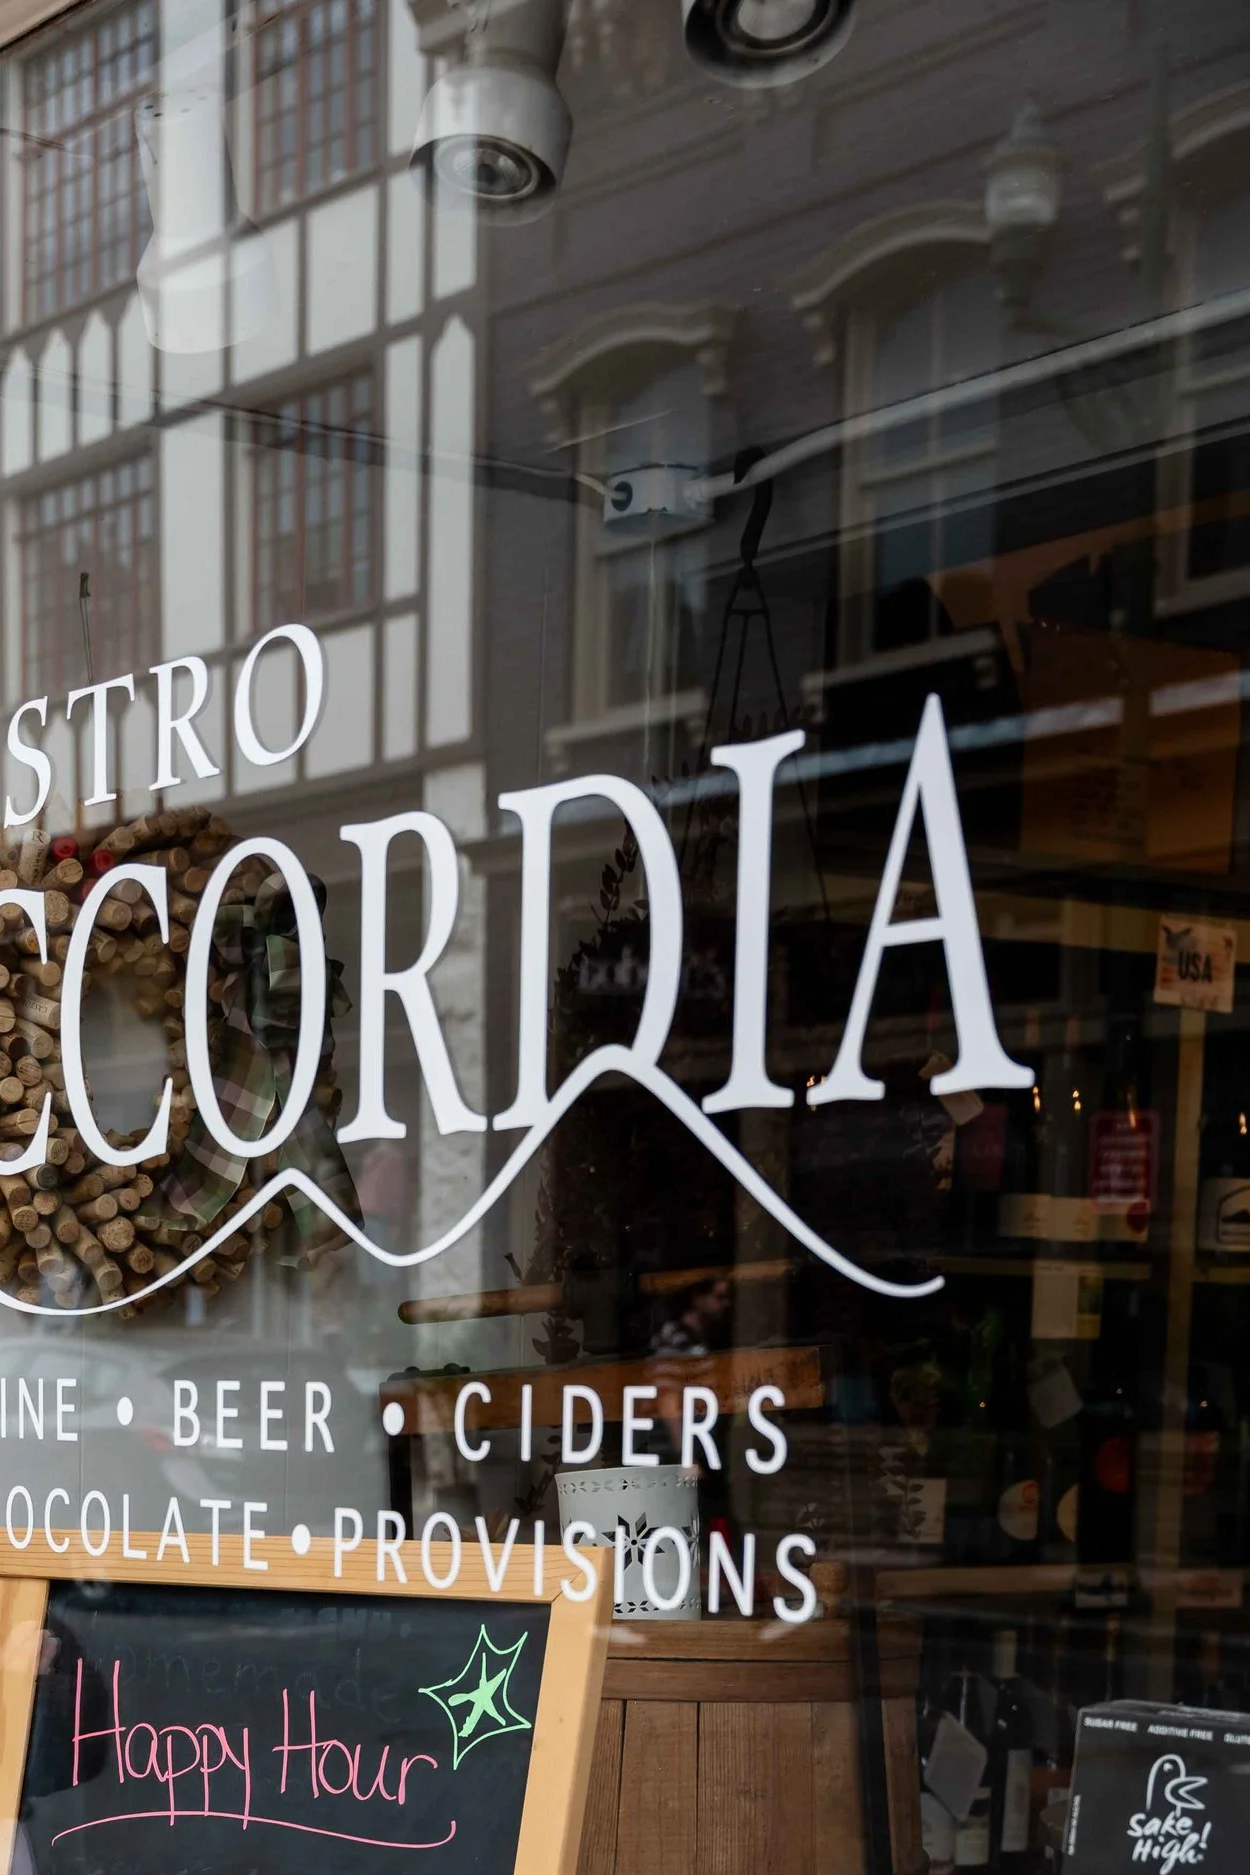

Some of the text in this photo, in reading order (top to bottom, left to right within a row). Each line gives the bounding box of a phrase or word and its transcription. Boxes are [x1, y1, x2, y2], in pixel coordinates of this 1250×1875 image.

[1178, 949, 1212, 983] USA
[172, 1379, 335, 1454] BEER
[454, 1382, 789, 1475] CIDERS
[332, 1506, 819, 1624] PROVISIONS
[72, 1657, 439, 1831] Happy Hour
[1127, 1806, 1193, 1839] Sake
